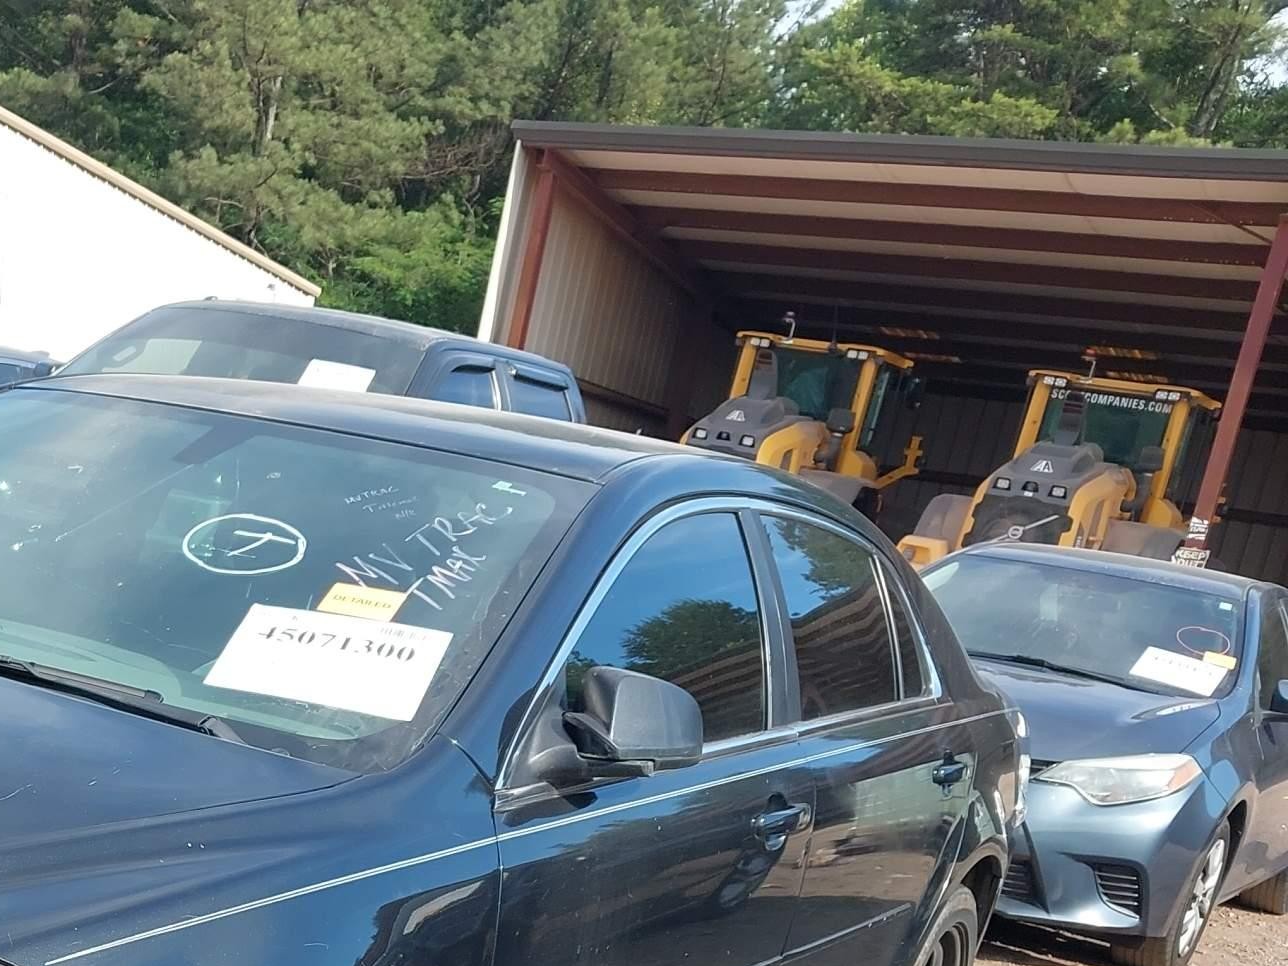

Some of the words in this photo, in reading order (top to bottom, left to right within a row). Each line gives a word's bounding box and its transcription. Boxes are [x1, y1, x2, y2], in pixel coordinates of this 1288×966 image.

[1050, 388, 1174, 414] SCCOMPANIES.COM
[332, 593, 393, 609] DETAILED
[257, 626, 416, 663] 45071300
